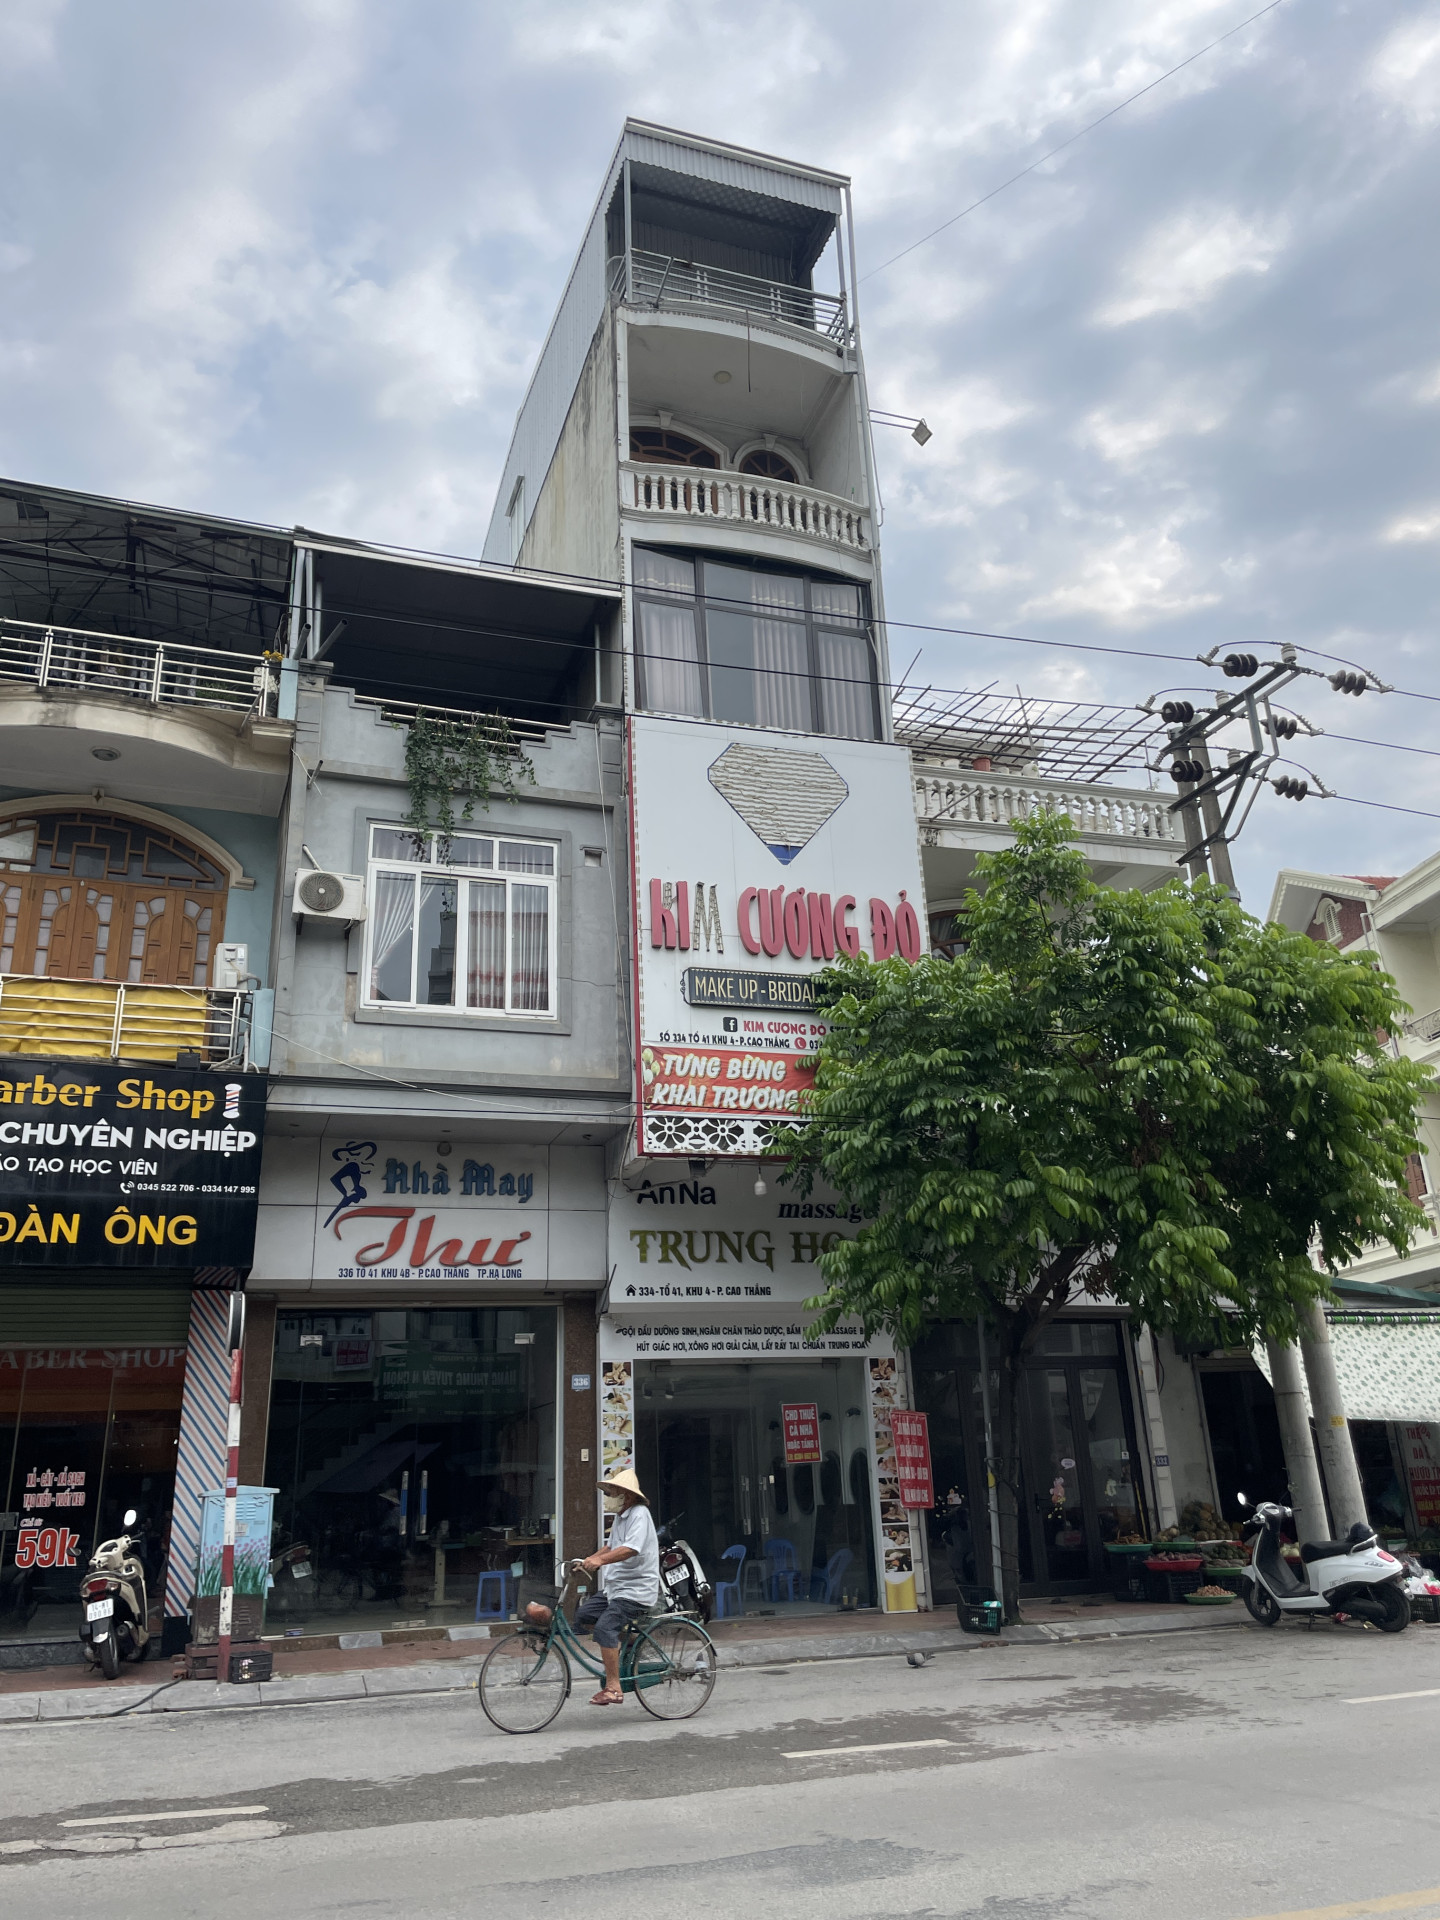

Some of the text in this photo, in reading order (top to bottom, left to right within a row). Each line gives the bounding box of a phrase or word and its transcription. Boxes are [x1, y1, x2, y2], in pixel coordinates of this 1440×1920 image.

[649, 878, 921, 963] KIM CƯƠNG ĐỎ
[695, 976, 735, 999] MAKE
[739, 979, 758, 1000] UP
[743, 1020, 765, 1033] KIM
[768, 1021, 806, 1035] CƯƠNG
[810, 1022, 826, 1036] ĐỎ
[659, 1030, 671, 1042] SỐ
[673, 1033, 686, 1043] 334
[702, 1035, 710, 1044] 41
[712, 1035, 728, 1045] KHU
[663, 1053, 786, 1082] TƯNG BỪNG
[116, 1079, 215, 1119] Shop
[712, 1085, 798, 1111] TRƯƠNG
[0, 1118, 256, 1158] CHUYÊN NGHIỆP
[28, 1158, 64, 1175] TẠO
[70, 1159, 112, 1177] HỌC
[119, 1158, 157, 1175] VIÊN
[137, 1182, 159, 1191] 0345
[160, 1183, 177, 1191] 522
[179, 1184, 194, 1192] 706
[201, 1184, 222, 1193] 0334
[223, 1185, 238, 1193] 147
[382, 1158, 534, 1204] Nhà May
[0, 1204, 197, 1245] ĐÀN ÔNG
[334, 1206, 532, 1267] Thư
[629, 1229, 775, 1273] TRUNG
[338, 1268, 353, 1278] 336
[368, 1268, 378, 1278] 41
[381, 1268, 397, 1278] KHU
[400, 1268, 410, 1278] 4B
[502, 1269, 522, 1279] LONG
[686, 1286, 703, 1296] KHU
[705, 1286, 710, 1295] 4
[725, 1286, 741, 1296] CAO
[622, 1326, 635, 1337] GỘI
[744, 1323, 762, 1335] THẢO
[637, 1340, 649, 1351] HÚT
[652, 1340, 670, 1351] GIÁC
[688, 1340, 709, 1351] XÔNG
[726, 1339, 740, 1350] GIẢI
[761, 1338, 773, 1350] LẤY
[775, 1339, 787, 1350] RÁY
[789, 1341, 799, 1350] TAI
[828, 1341, 850, 1350] TRUNG
[852, 1341, 866, 1349] HOA
[573, 1377, 589, 1386] 336
[785, 1406, 816, 1421] CHO THUÊ
[789, 1421, 814, 1437] CẢ NHÀ
[815, 1439, 818, 1449] 1
